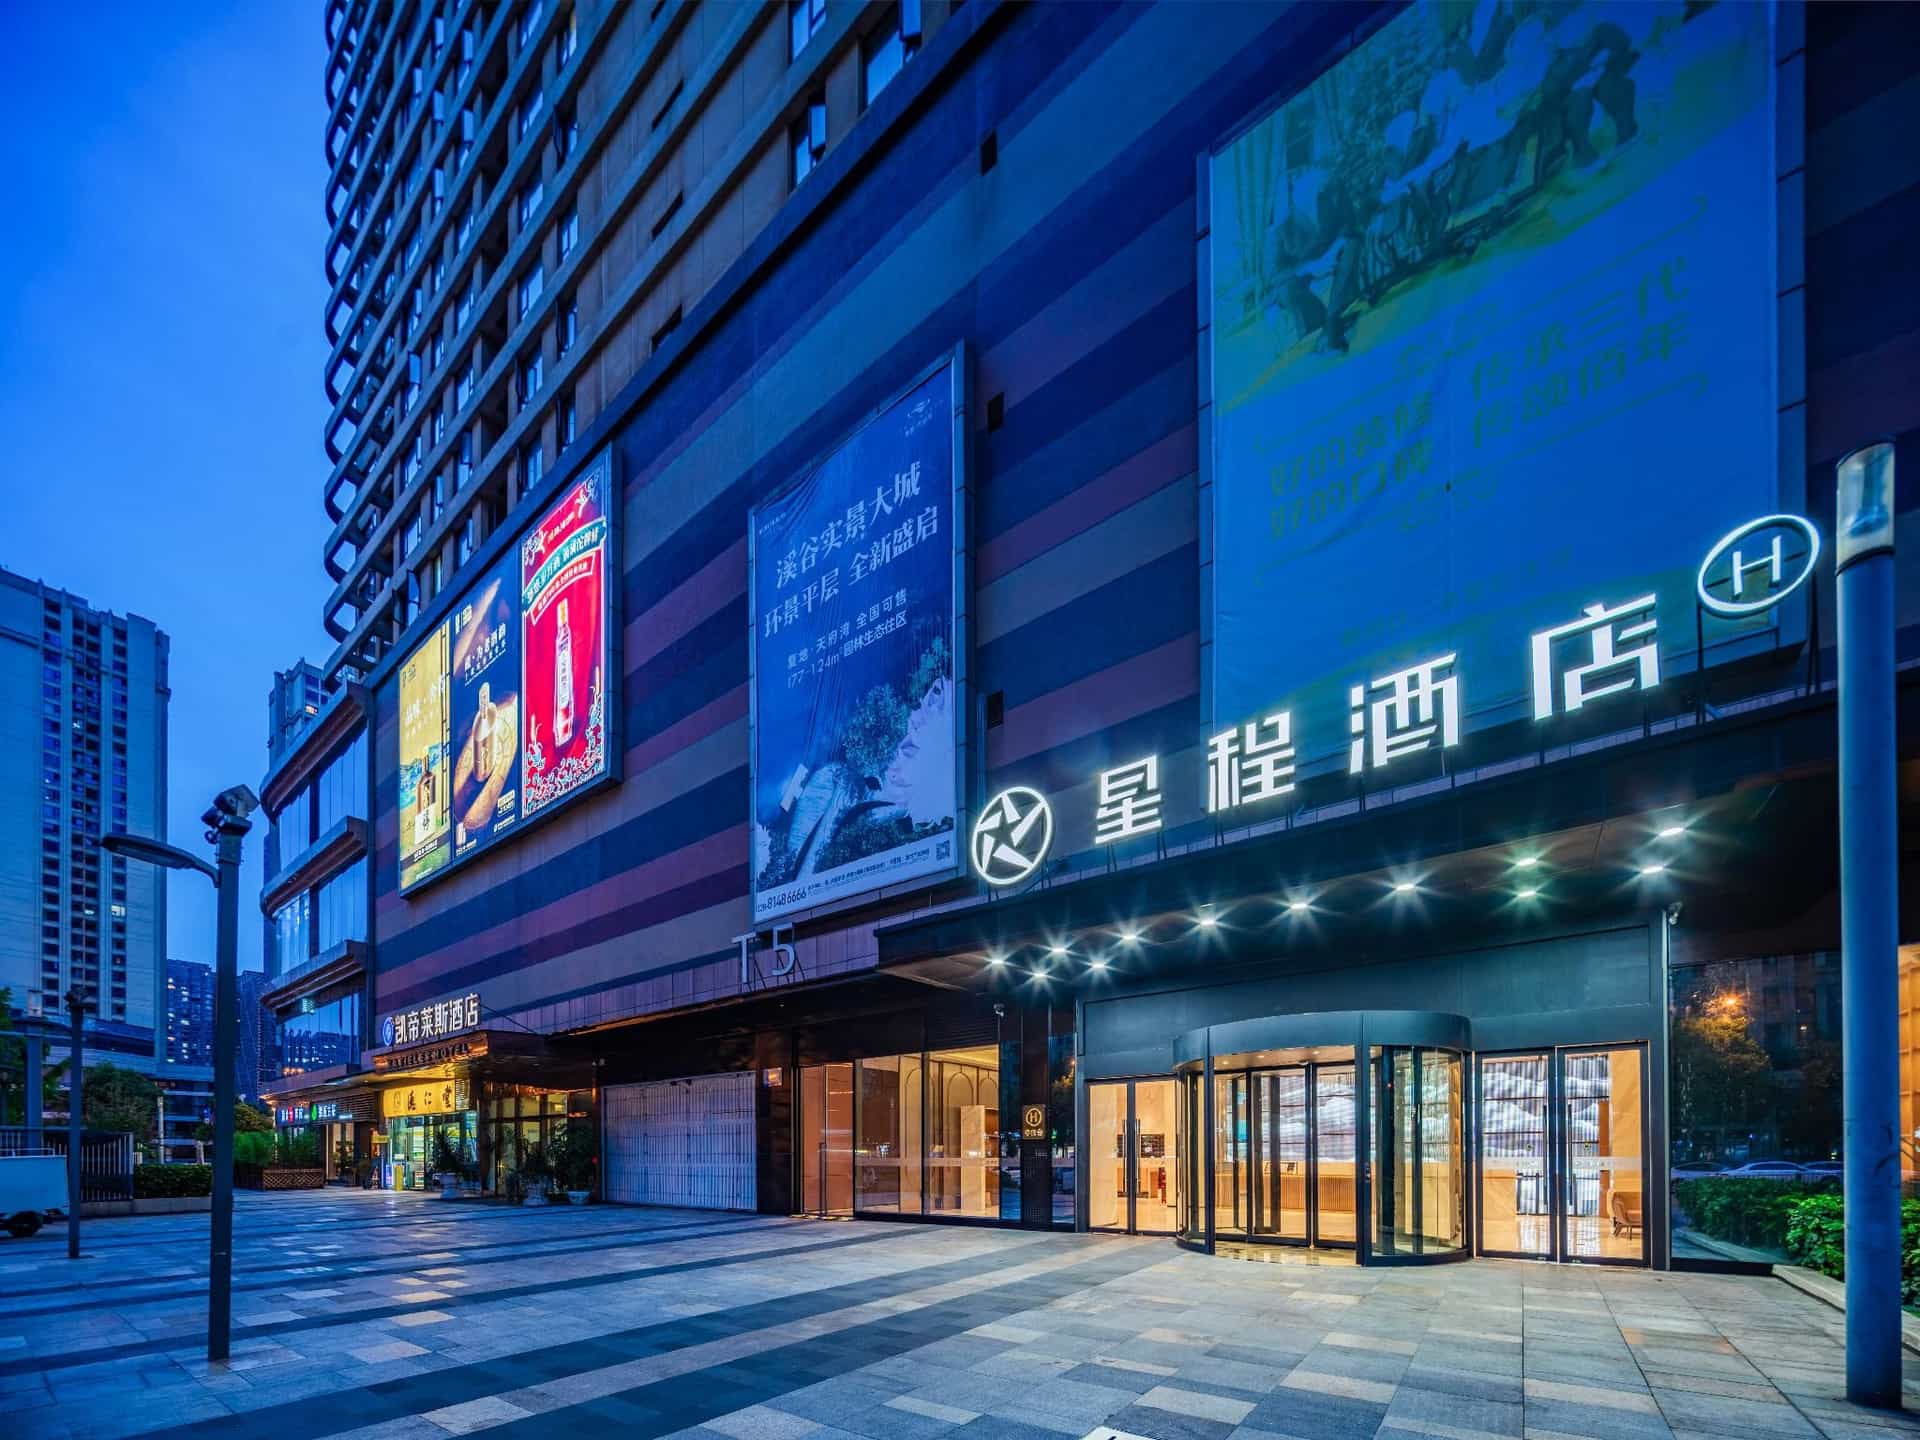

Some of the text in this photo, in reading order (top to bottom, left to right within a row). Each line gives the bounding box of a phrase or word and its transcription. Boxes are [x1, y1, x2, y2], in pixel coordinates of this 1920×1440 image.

[763, 505, 940, 639] 环景平层 全新盛启
[775, 460, 922, 589] 溪谷实景大城
[1094, 592, 1663, 846] 星程酒店
[394, 992, 480, 1044] 凯帝莱斯酒店
